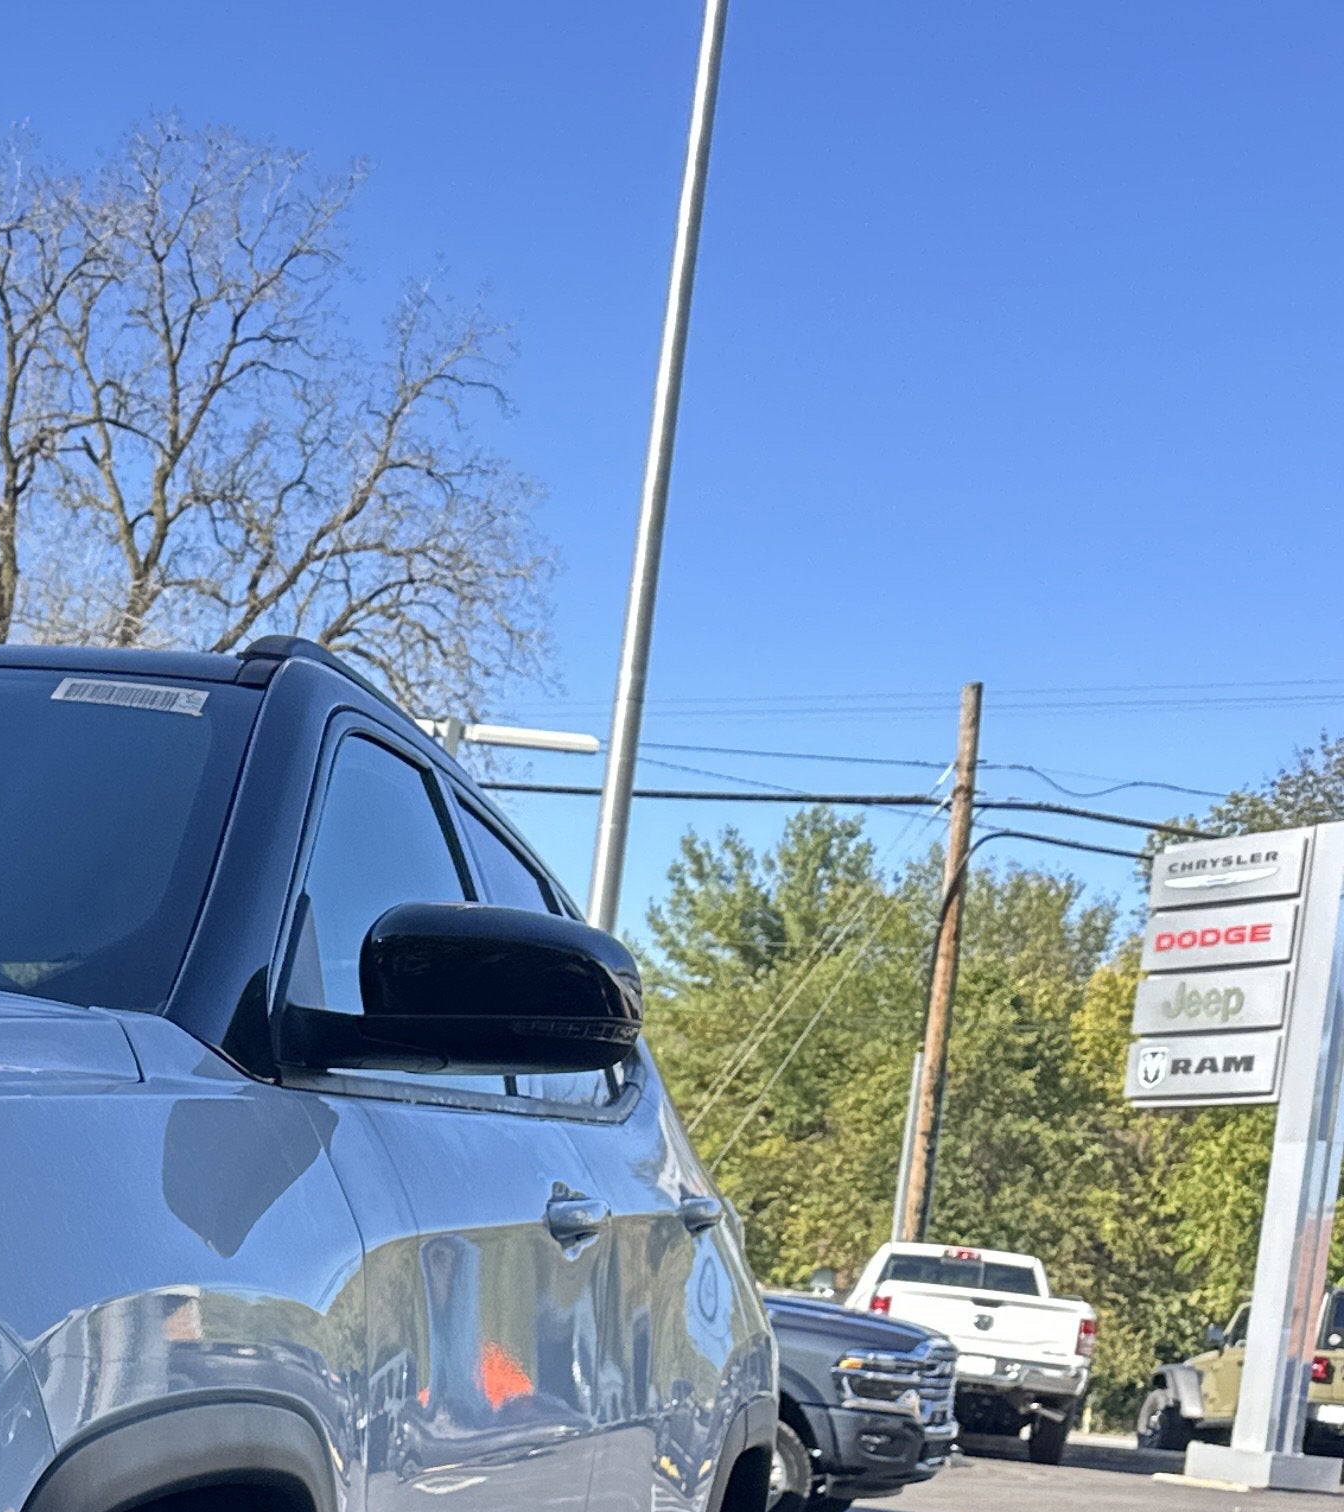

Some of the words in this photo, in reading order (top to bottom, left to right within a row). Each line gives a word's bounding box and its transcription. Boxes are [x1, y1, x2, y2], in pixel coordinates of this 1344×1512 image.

[1168, 851, 1279, 873] CHRYSLER
[1155, 924, 1272, 952] DODGE
[1162, 982, 1244, 1022] Jeep
[1170, 1055, 1255, 1075] RAM
